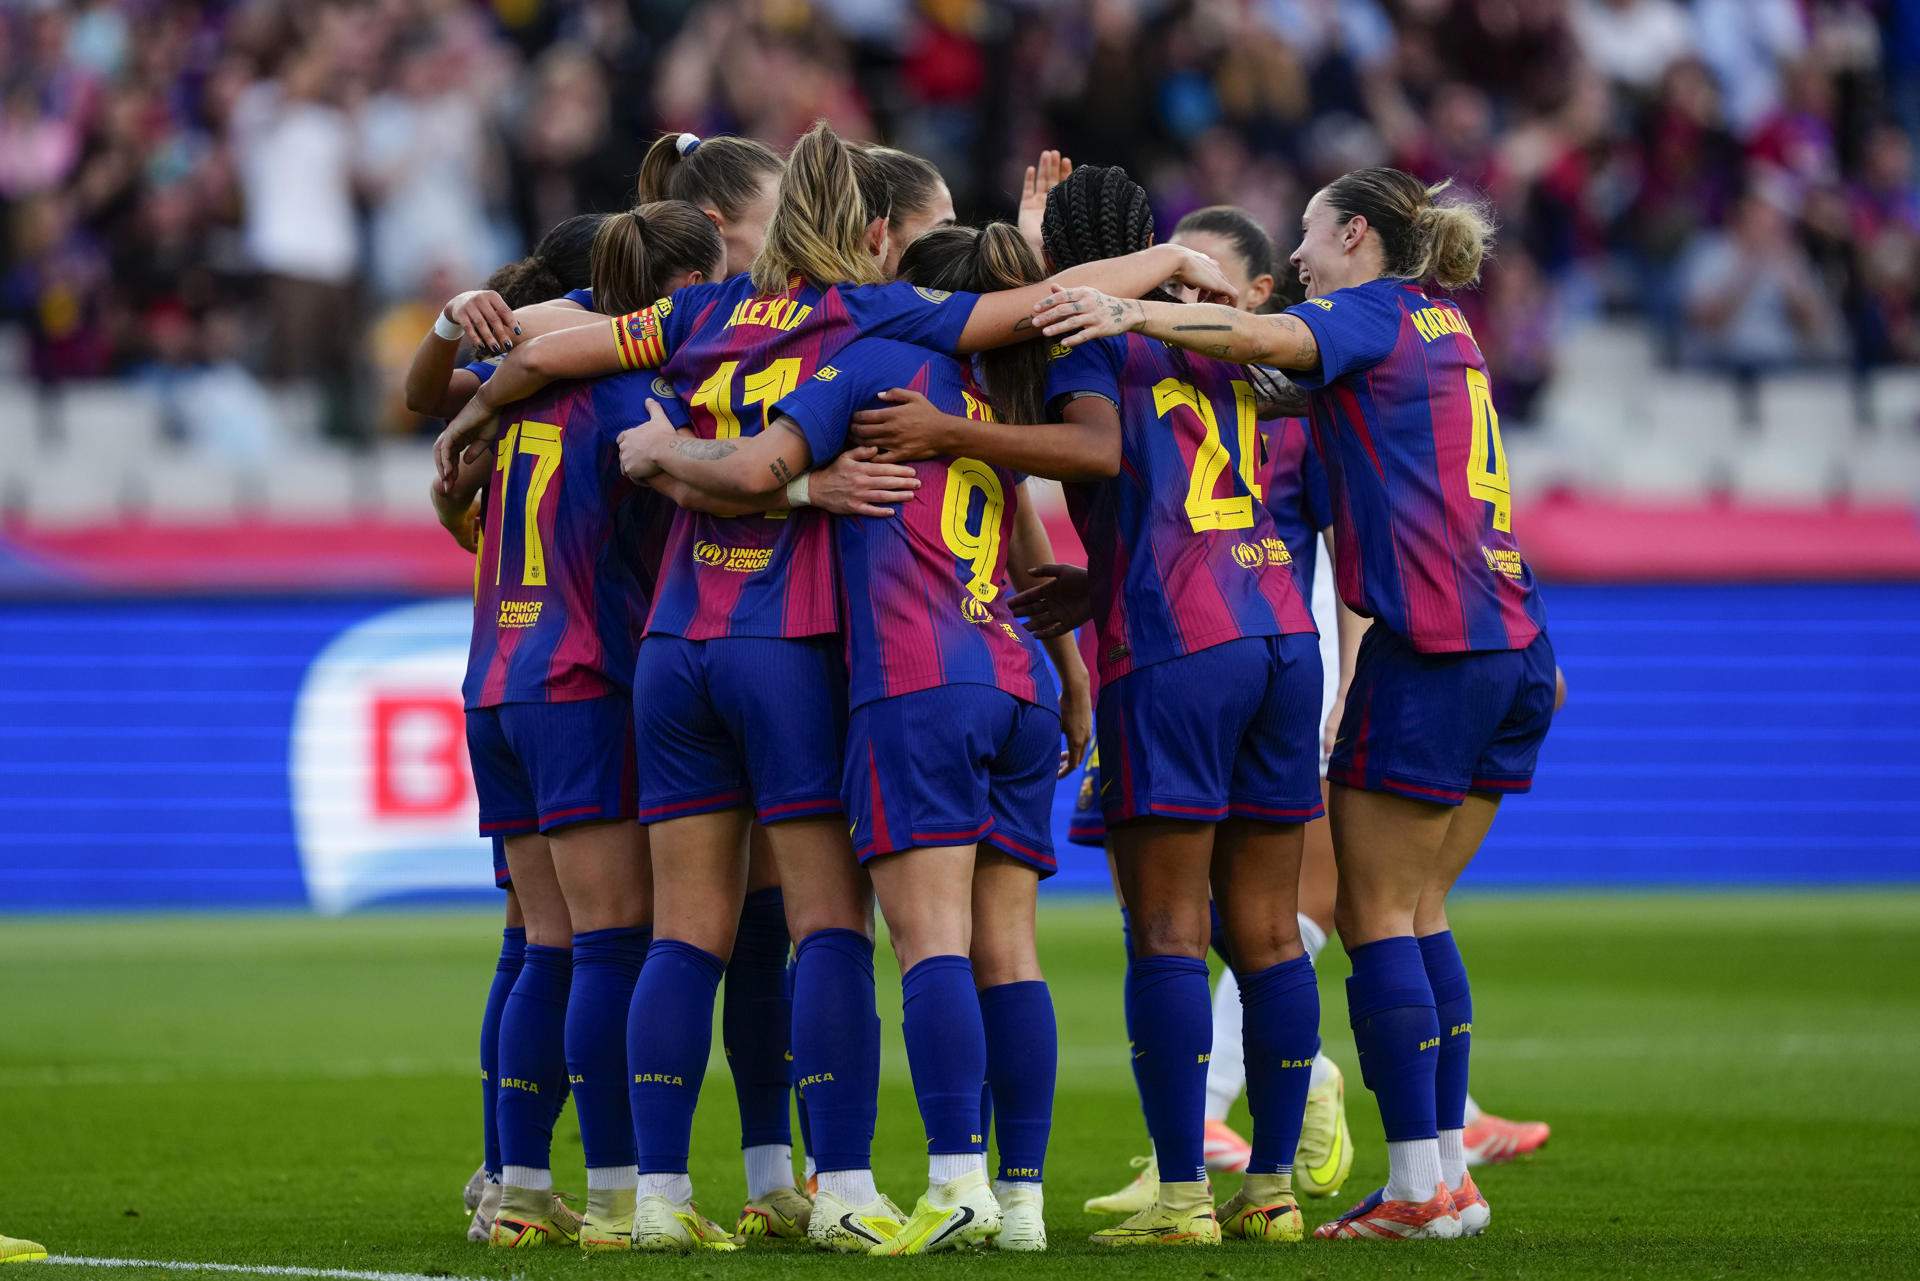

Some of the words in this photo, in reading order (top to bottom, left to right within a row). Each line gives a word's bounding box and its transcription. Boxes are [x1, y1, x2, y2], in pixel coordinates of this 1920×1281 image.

[723, 299, 813, 331] ALEXIA
[1466, 367, 1511, 533] 4
[496, 420, 563, 586] 17
[941, 457, 1005, 603] 9
[730, 547, 774, 559] UNHCR
[724, 558, 769, 569] ACNUR
[501, 600, 543, 613] UNHCR
[498, 612, 539, 623] ACNUR
[501, 1078, 539, 1094] BARÇA
[634, 1073, 683, 1087] BARÇA
[1007, 1168, 1039, 1178] BARÇA
